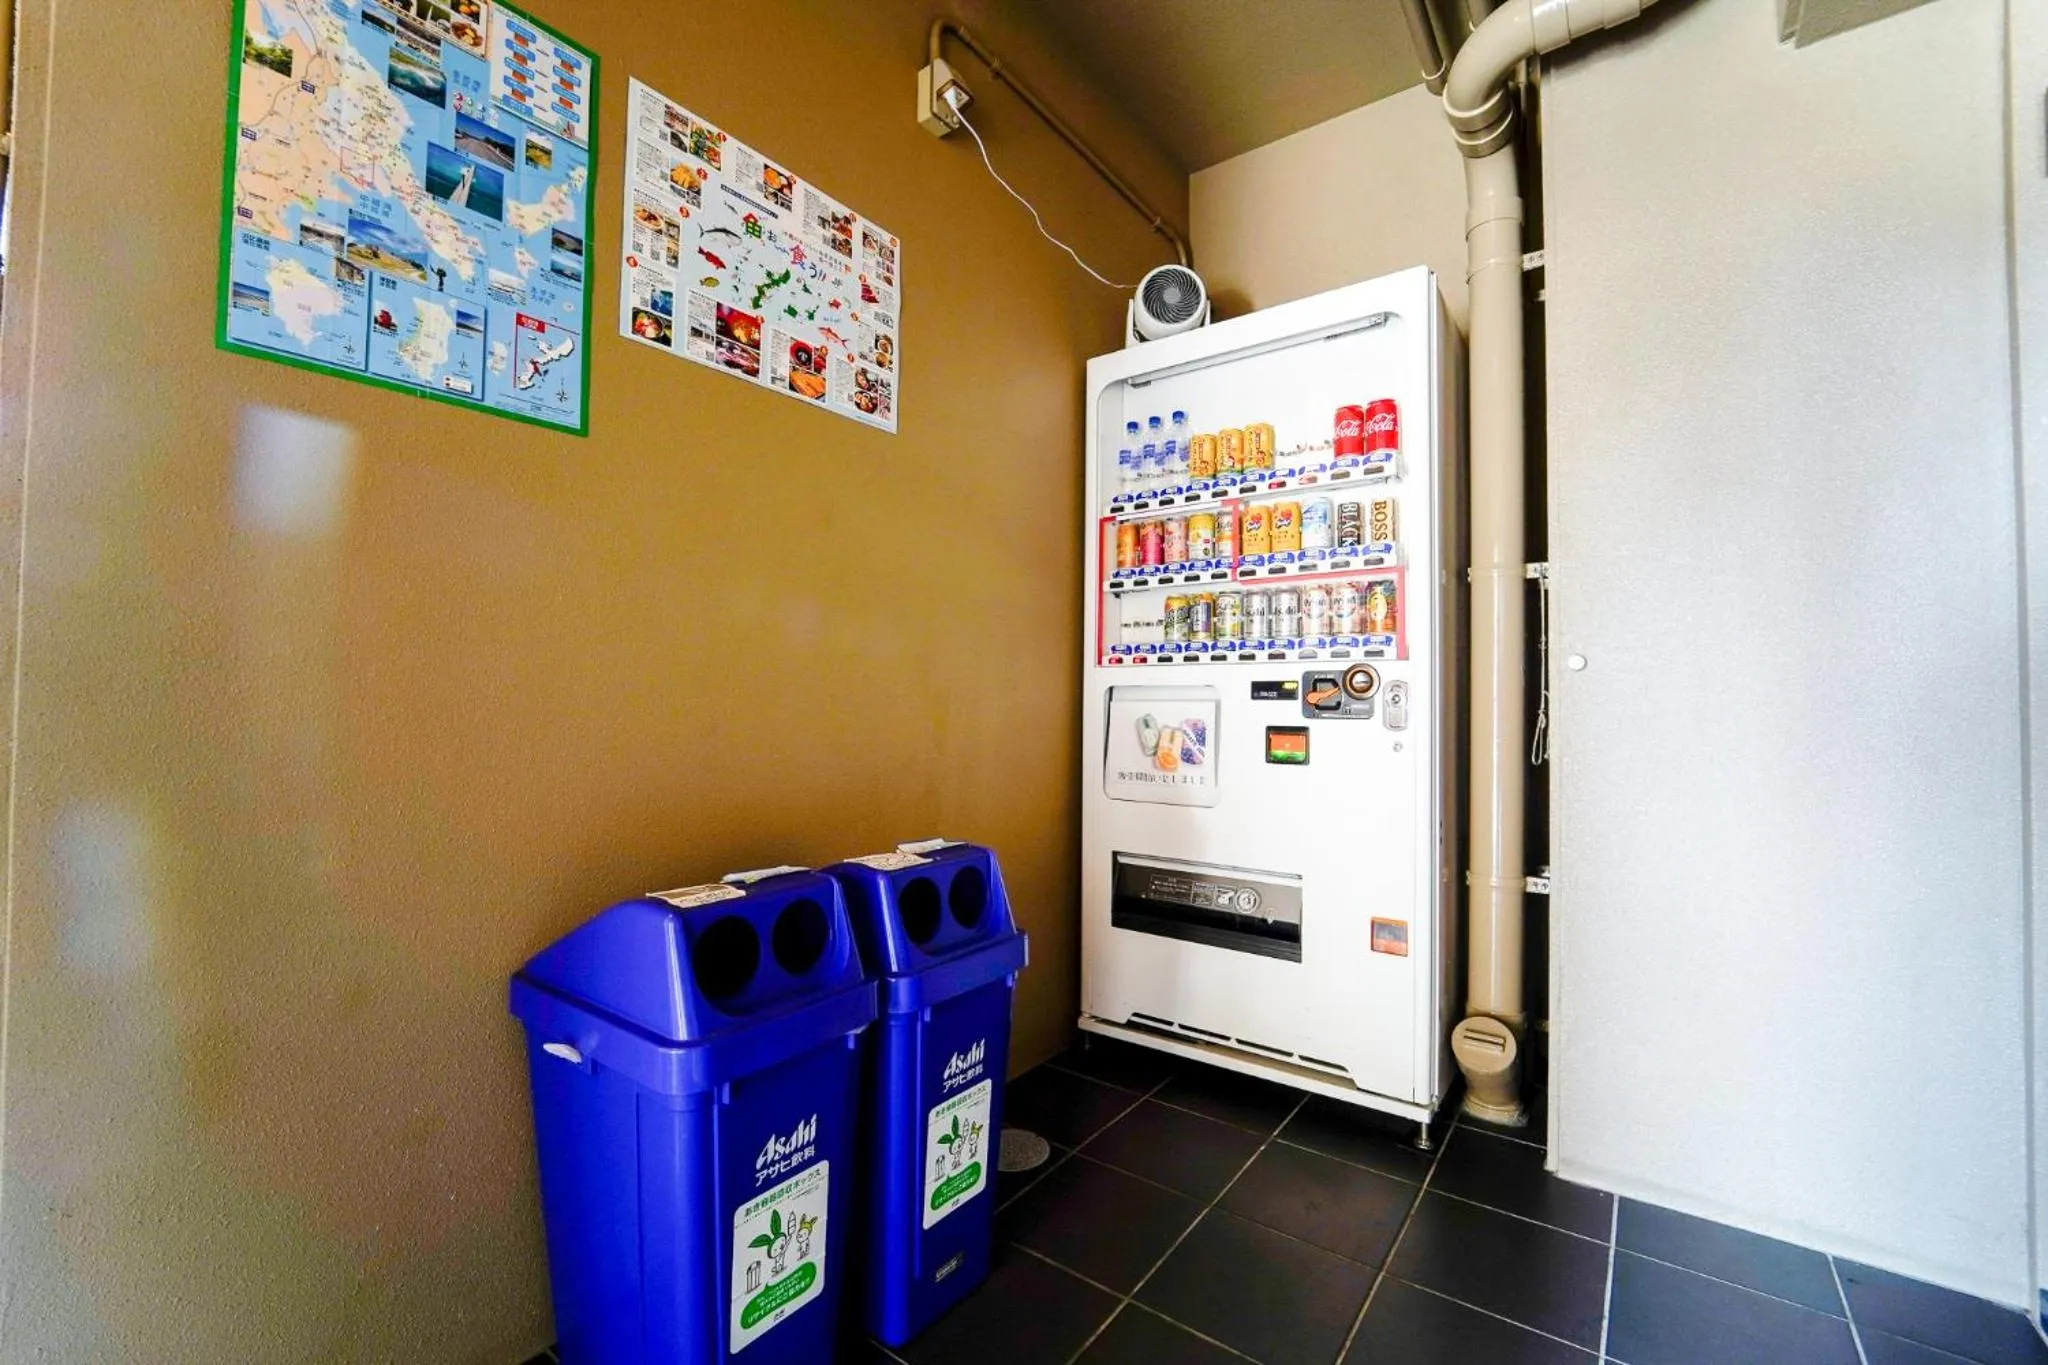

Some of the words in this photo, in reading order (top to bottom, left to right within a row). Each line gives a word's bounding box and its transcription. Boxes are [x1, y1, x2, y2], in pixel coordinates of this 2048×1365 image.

[1374, 501, 1388, 541] BOSS
[943, 1037, 985, 1080] Asahi
[943, 1063, 983, 1093] アサヒ飲料
[756, 1113, 817, 1170] Asahi
[755, 1144, 815, 1187] アサヒ飲料
